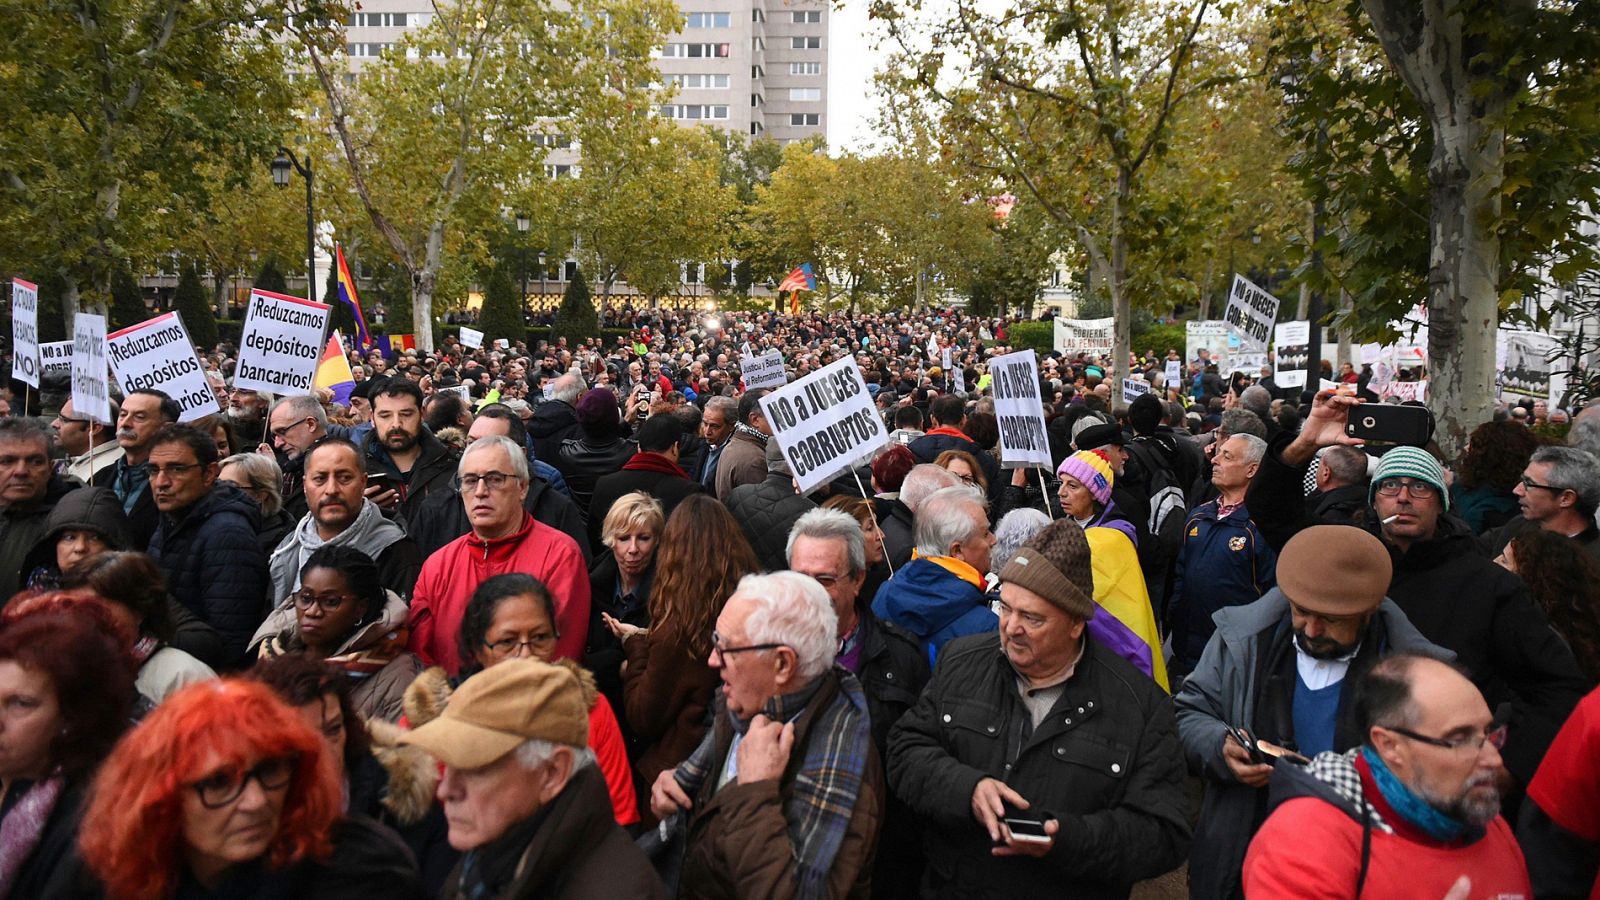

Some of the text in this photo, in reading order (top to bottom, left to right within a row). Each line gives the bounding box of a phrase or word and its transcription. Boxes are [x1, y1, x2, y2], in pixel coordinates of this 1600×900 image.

[1234, 279, 1246, 300] NO
[1244, 289, 1252, 304] a
[250, 297, 324, 330] ¡Reduzcamos
[42, 345, 54, 359] NO
[56, 347, 63, 358] a
[109, 325, 184, 369] ¡Reduzcamos
[246, 329, 318, 360] depósitos
[1079, 337, 1113, 349] PENSIONE
[14, 350, 38, 380] NO!
[125, 356, 199, 395] depósitos
[240, 359, 313, 390] bancarios!
[177, 382, 214, 413] arios!
[767, 365, 861, 434] NO a JUECES
[1002, 370, 1012, 399] a
[787, 407, 879, 477] CORRUPTOS
